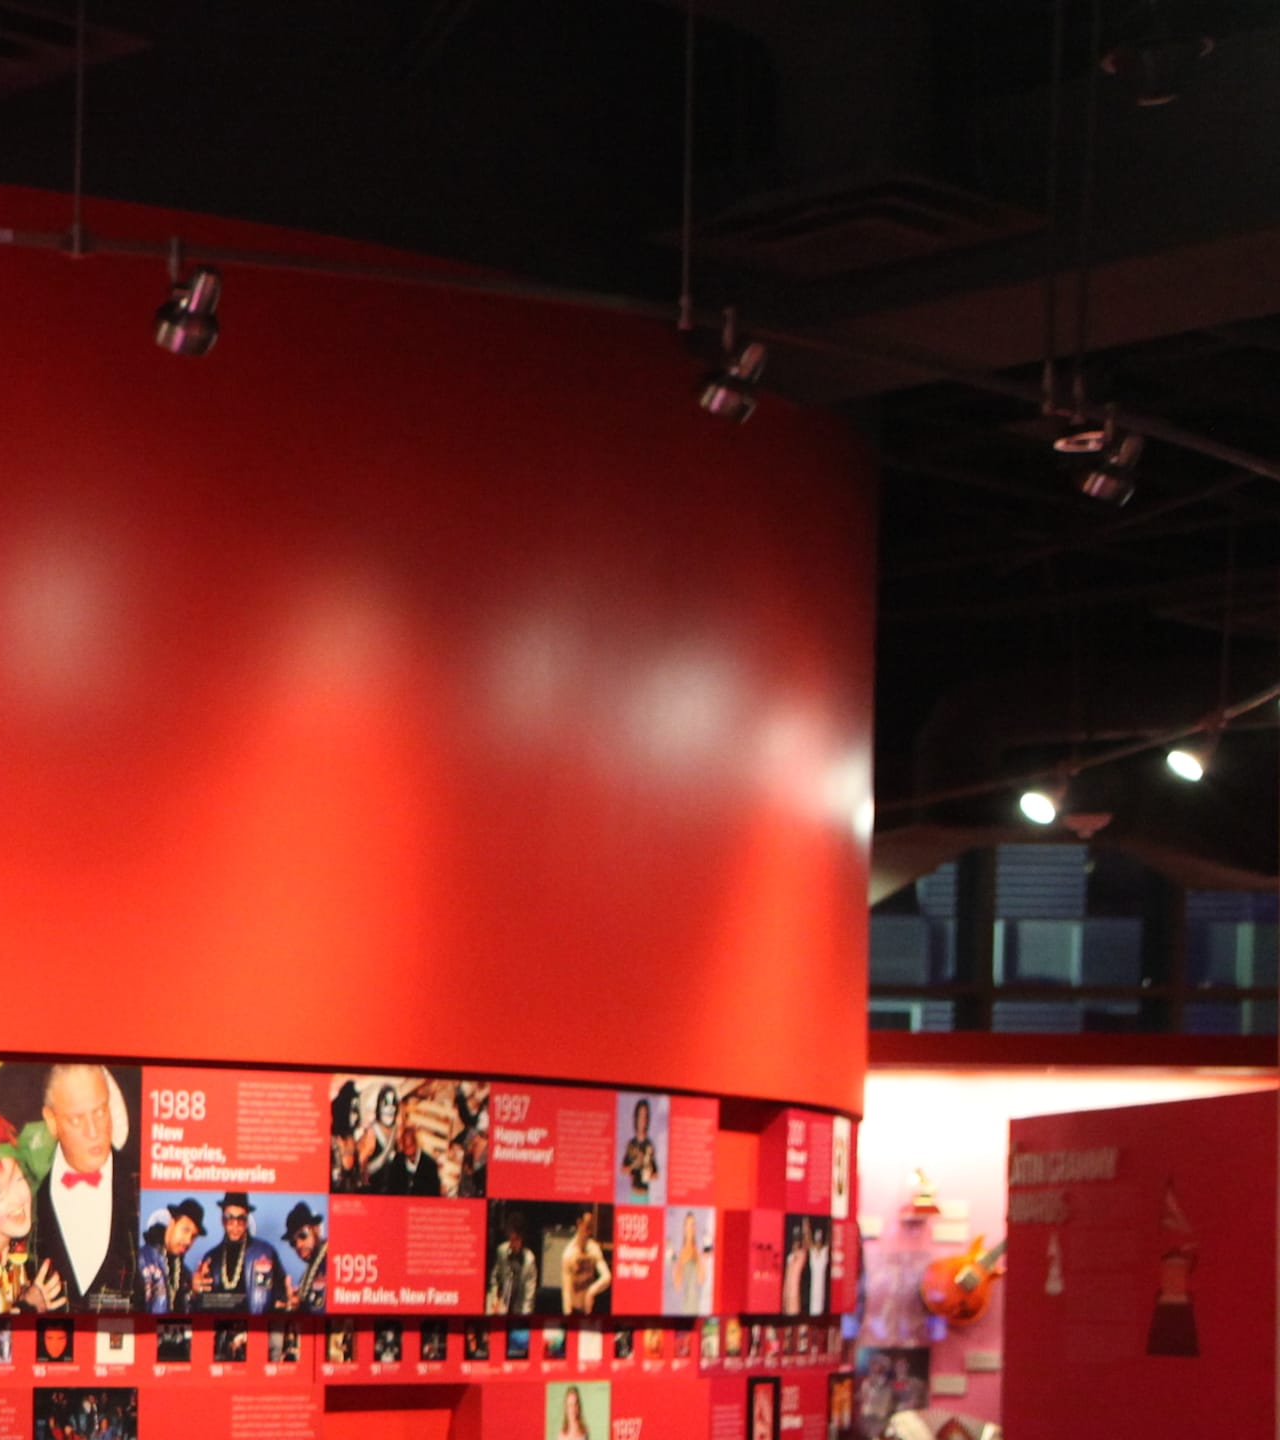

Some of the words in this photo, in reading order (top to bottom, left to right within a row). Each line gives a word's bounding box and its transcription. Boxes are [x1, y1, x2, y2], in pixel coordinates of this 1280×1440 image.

[150, 1090, 206, 1121] 1988
[151, 1124, 183, 1141] New
[151, 1143, 227, 1166] Categories,
[151, 1164, 183, 1182] New
[186, 1165, 276, 1184] Controversies
[333, 1254, 378, 1283] 1995
